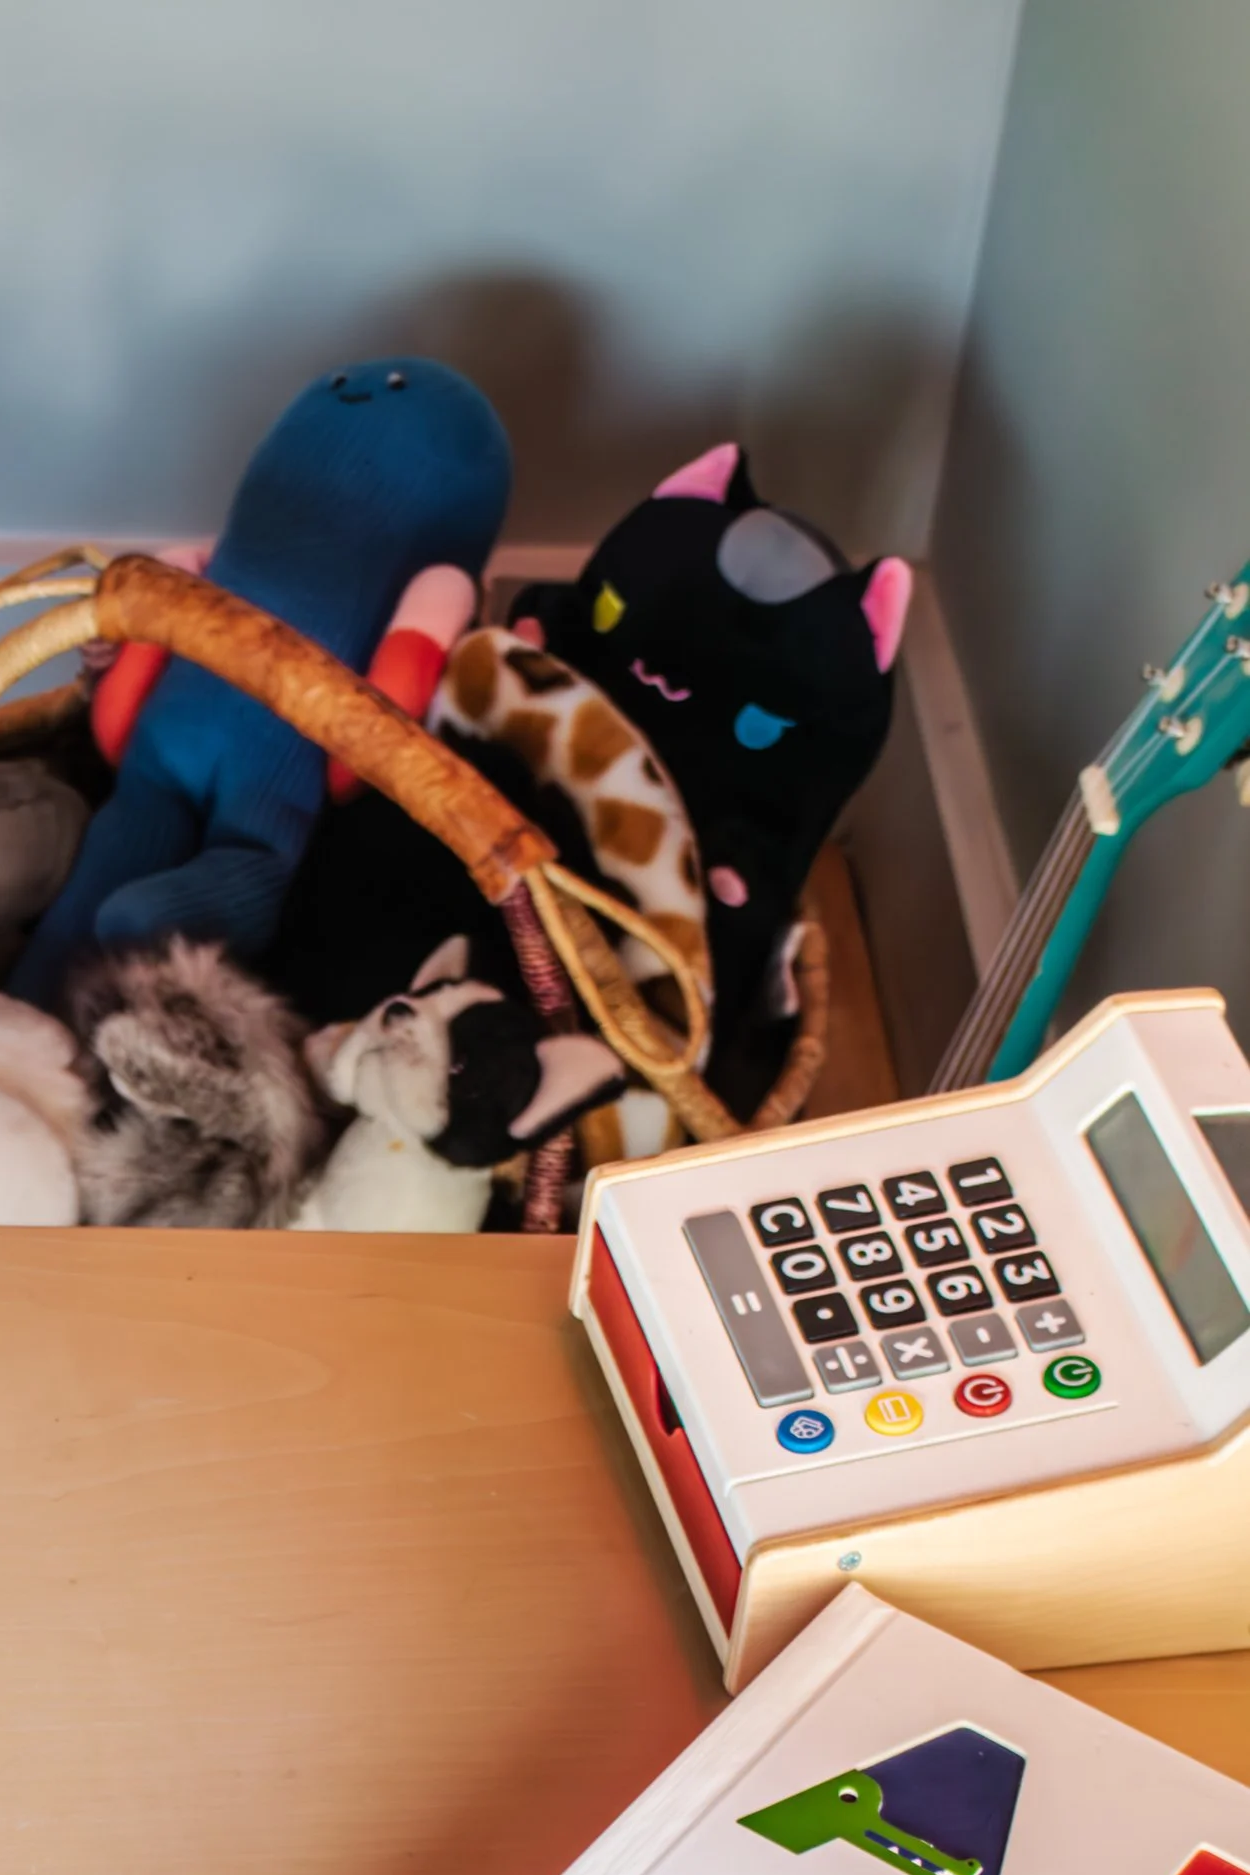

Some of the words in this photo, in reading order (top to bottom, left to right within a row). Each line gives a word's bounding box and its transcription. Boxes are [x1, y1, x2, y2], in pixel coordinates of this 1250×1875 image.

[959, 1167, 1002, 1188] 1
[825, 1191, 873, 1214] 7
[895, 1181, 938, 1207] 4
[760, 1204, 805, 1233] C
[978, 1212, 1025, 1239] 2
[913, 1226, 960, 1252] 5
[847, 1240, 893, 1266] 8
[1003, 1258, 1051, 1286] 3
[936, 1274, 983, 1301] 6
[869, 1288, 915, 1314] 9
